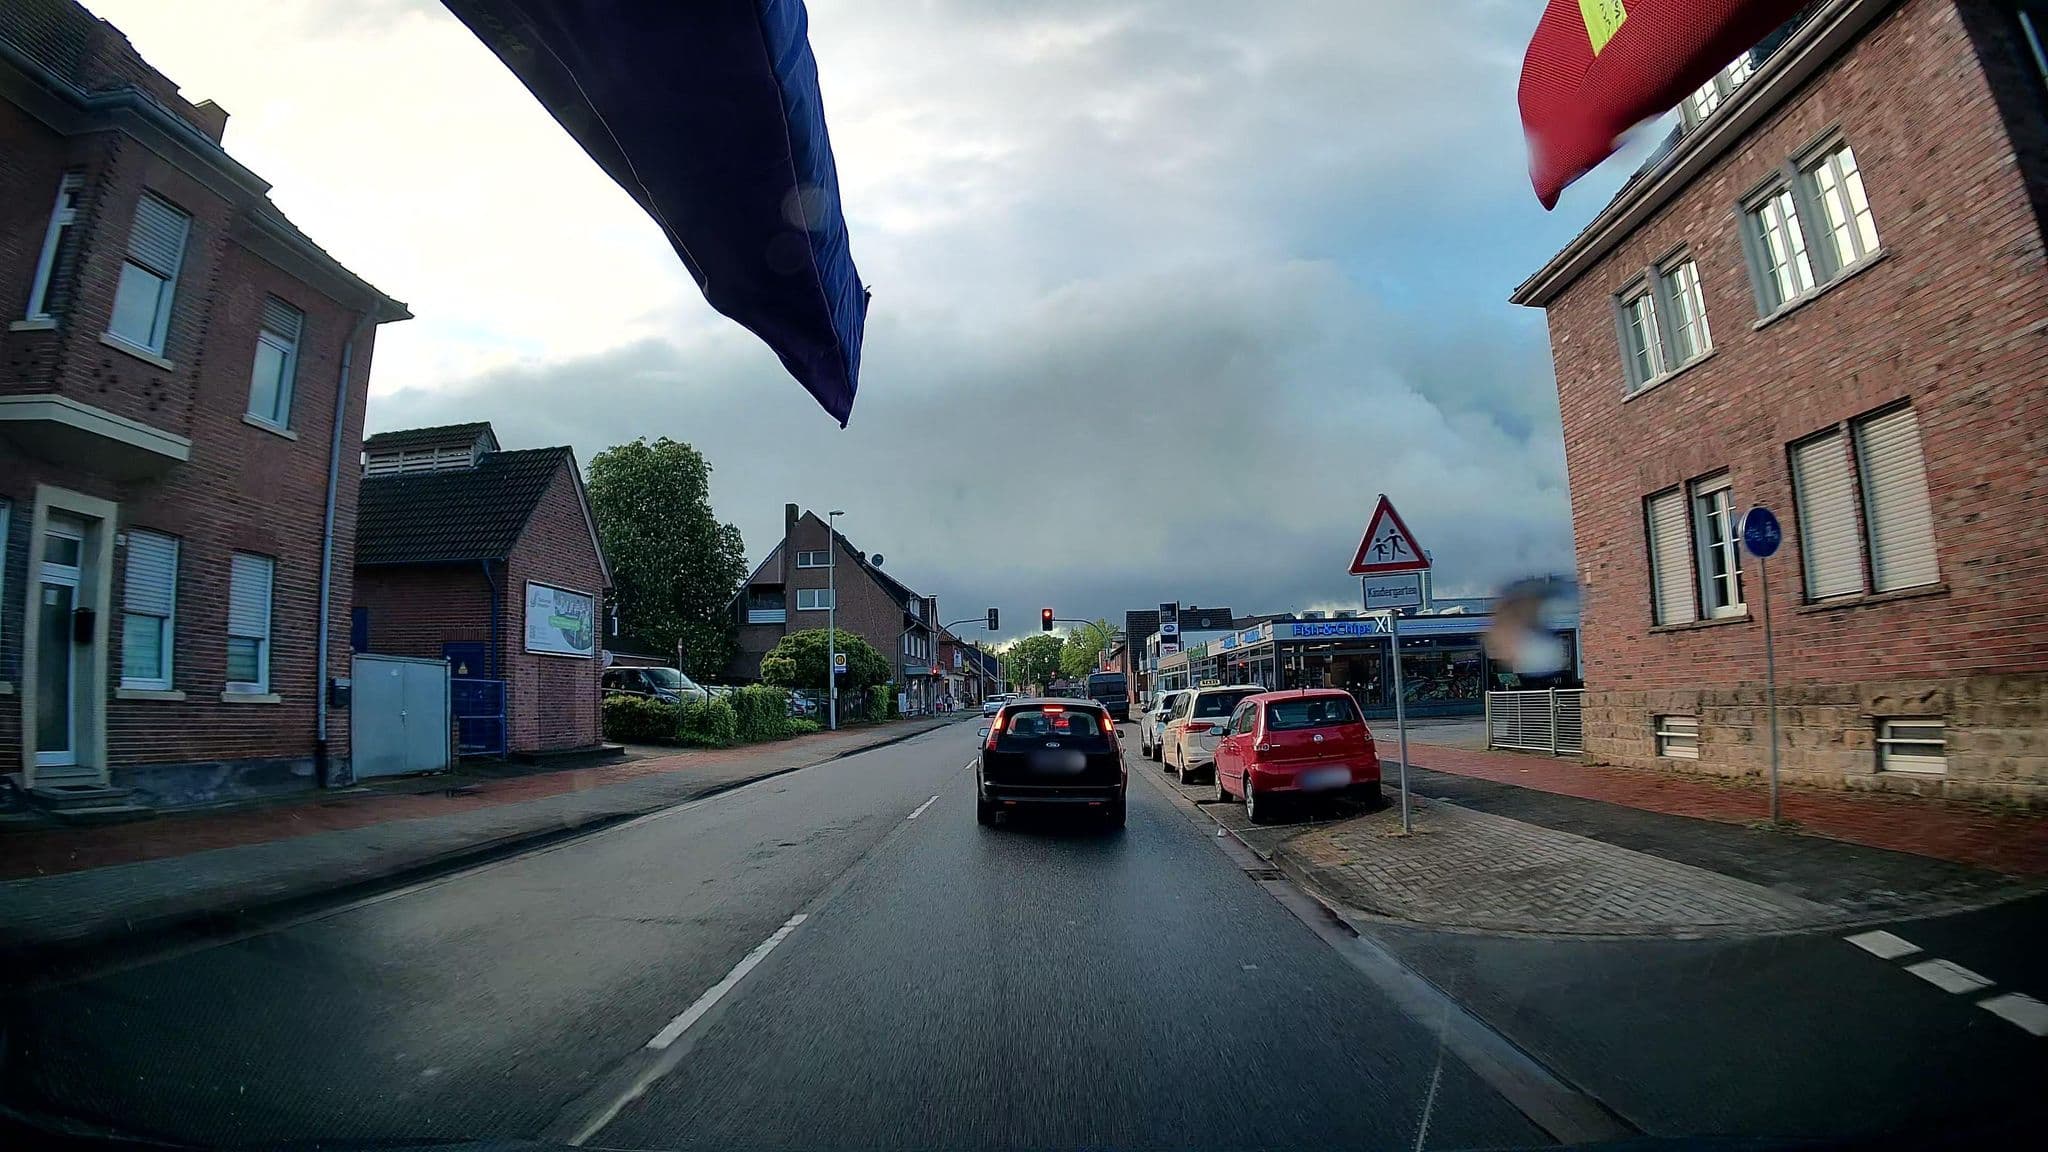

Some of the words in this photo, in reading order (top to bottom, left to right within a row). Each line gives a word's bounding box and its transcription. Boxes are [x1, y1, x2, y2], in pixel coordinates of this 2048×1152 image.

[1367, 586, 1417, 598] Kindergarten
[1294, 624, 1319, 636] Fish
[1322, 623, 1333, 635] &
[1335, 622, 1372, 636] Chips
